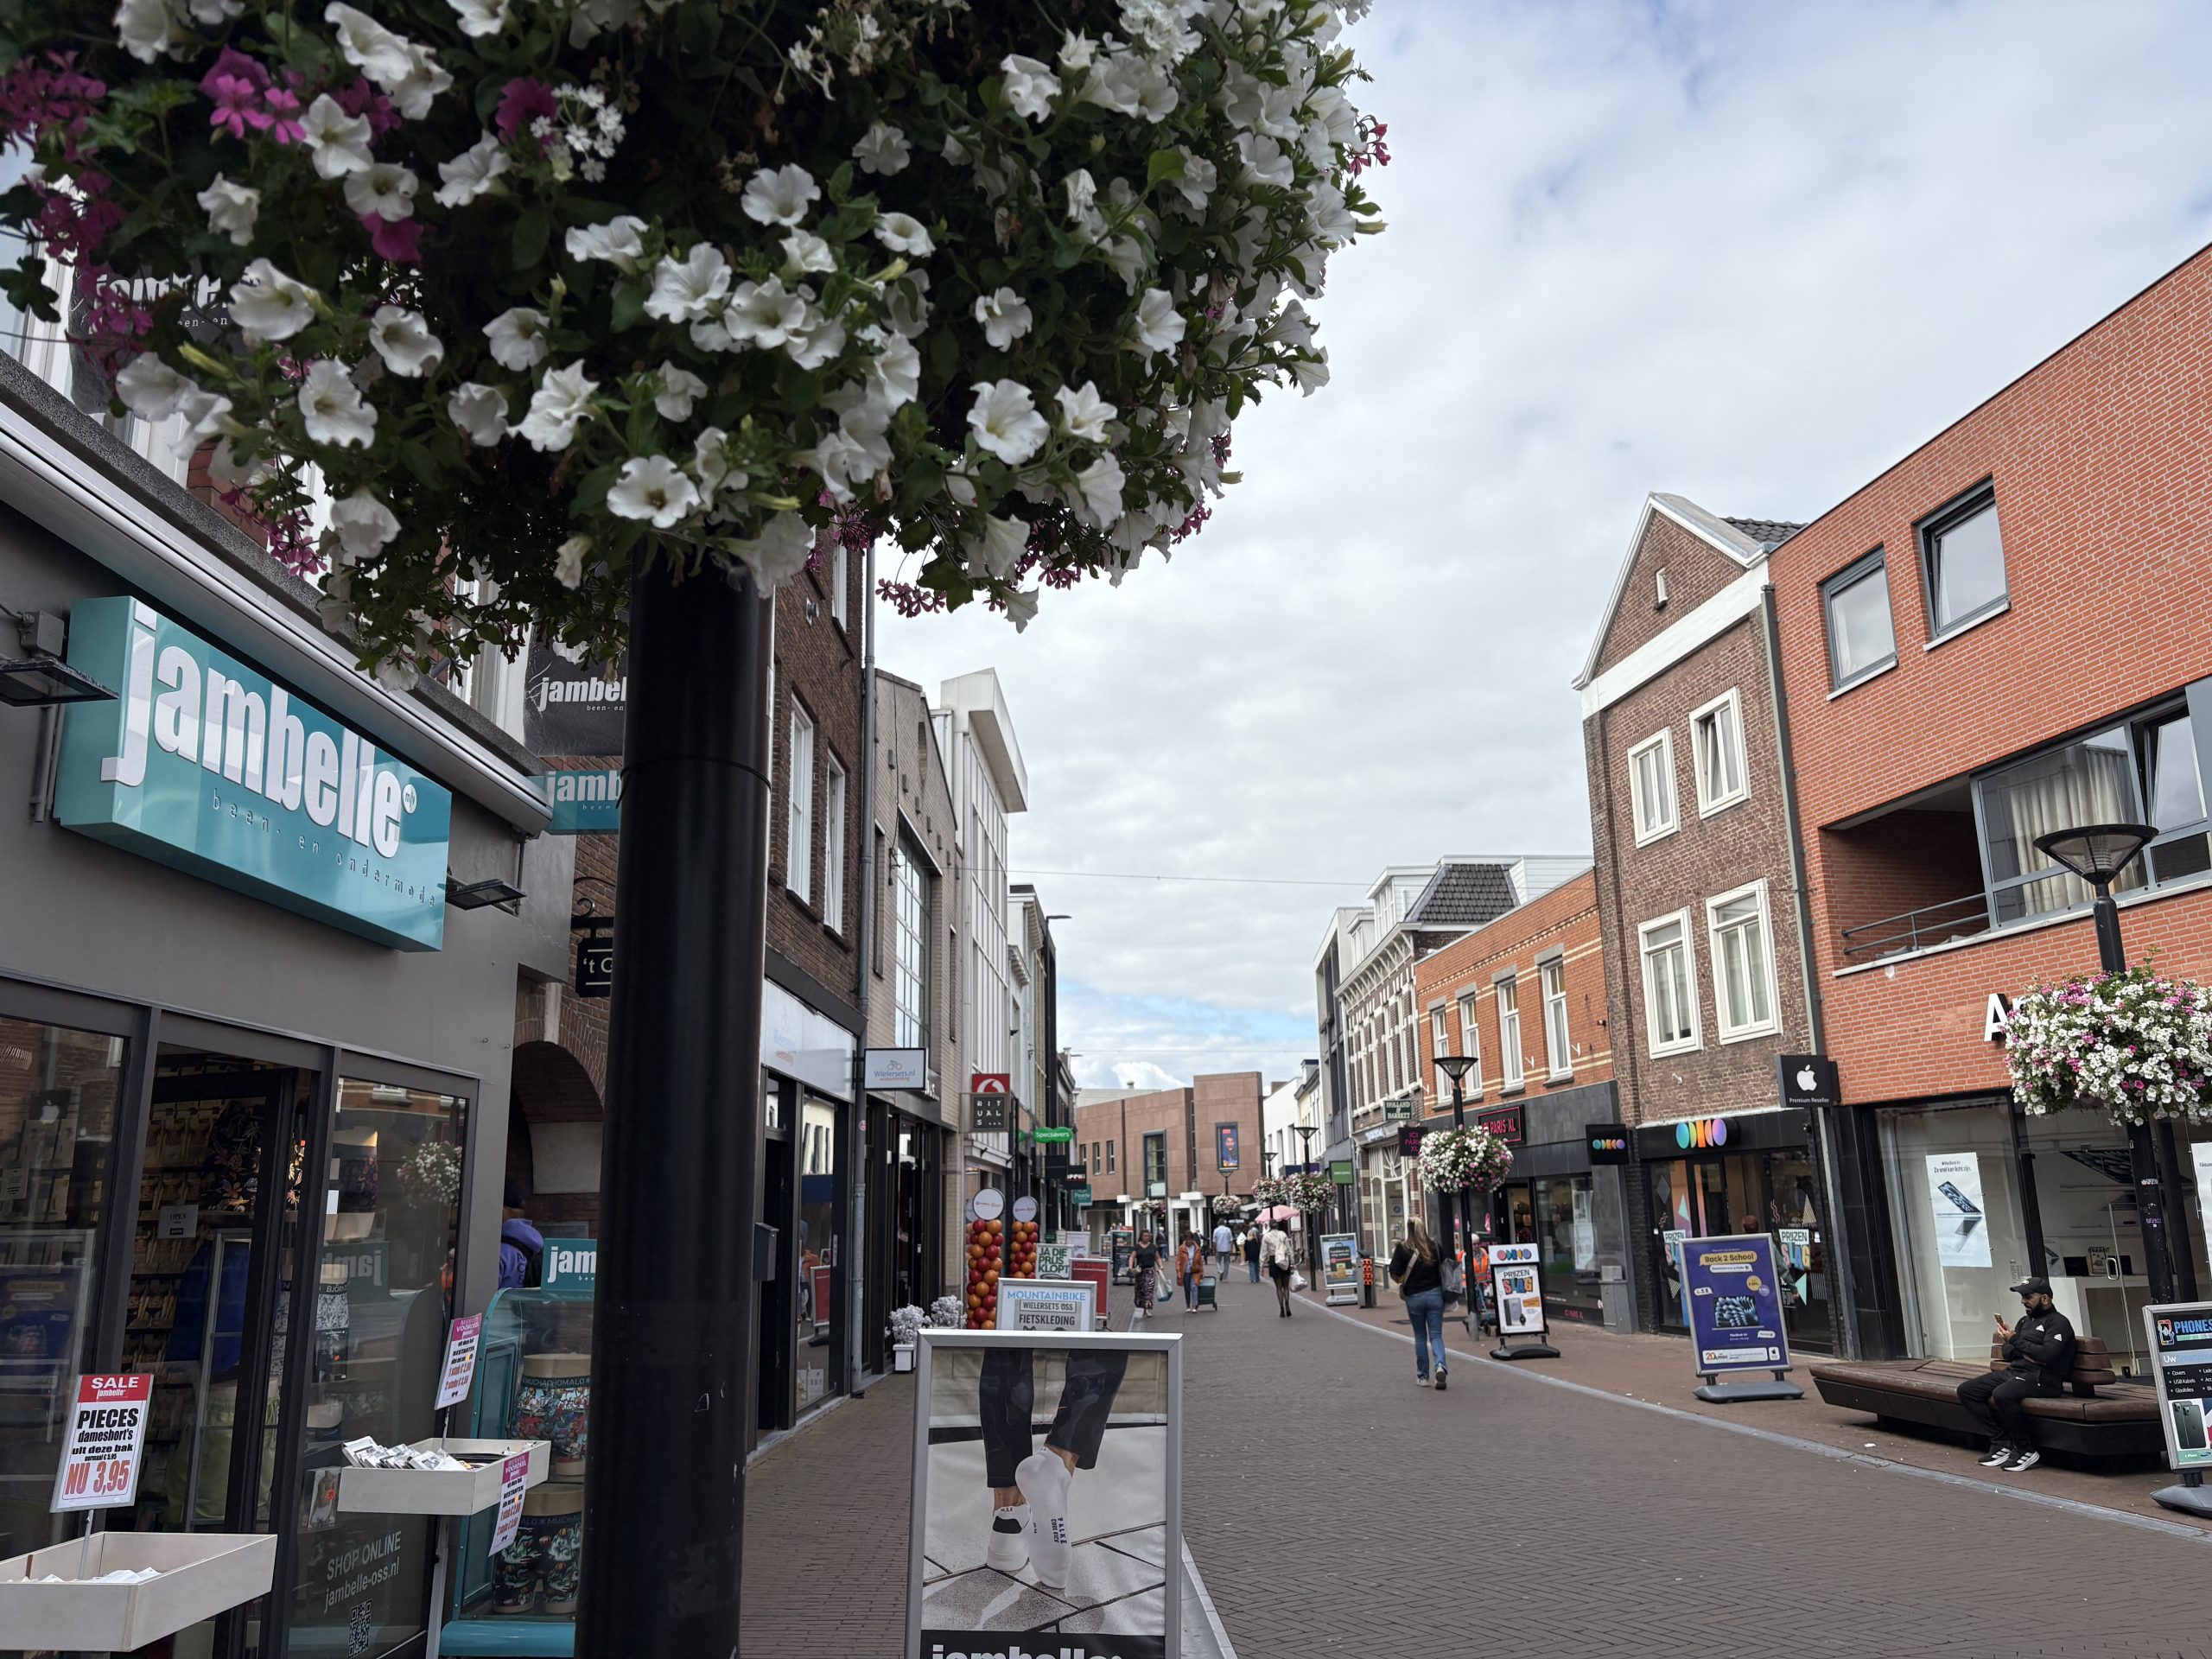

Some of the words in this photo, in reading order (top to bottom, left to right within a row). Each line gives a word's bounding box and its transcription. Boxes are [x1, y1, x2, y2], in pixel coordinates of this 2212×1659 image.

[101, 601, 400, 858] jambelle
[336, 851, 435, 908] ondermode
[1490, 1119, 1506, 1135] PARIS
[1508, 1117, 1516, 1132] XL
[1781, 1231, 1808, 1242] PRIJZEN
[1039, 1248, 1051, 1256] JA
[1052, 1248, 1067, 1256] DIE
[1039, 1255, 1065, 1264] PRIJS
[1705, 1255, 1722, 1263] Back
[1729, 1253, 1754, 1262] School
[1038, 1264, 1071, 1273] KLOPT
[1503, 1268, 1530, 1279] PRIJZEN
[1007, 1290, 1086, 1300] MOUNTAINBIKE
[1023, 1301, 1059, 1310] WIELERSETS
[1019, 1314, 1075, 1325] FIETSKLEDING
[2164, 1355, 2177, 1363] Uw
[91, 1376, 139, 1389] SALE
[77, 1408, 138, 1429] PIECES
[78, 1428, 134, 1443] dameshort's
[72, 1446, 86, 1455] uit
[88, 1445, 112, 1454] deze
[114, 1444, 133, 1452] bak
[65, 1462, 90, 1495] NU
[93, 1460, 130, 1495] 3,95
[1058, 1517, 1067, 1544] FALKE
[327, 1549, 359, 1580] SHOP
[362, 1530, 401, 1565] ONLINE
[324, 1556, 400, 1614] jambelle-oss.nl
